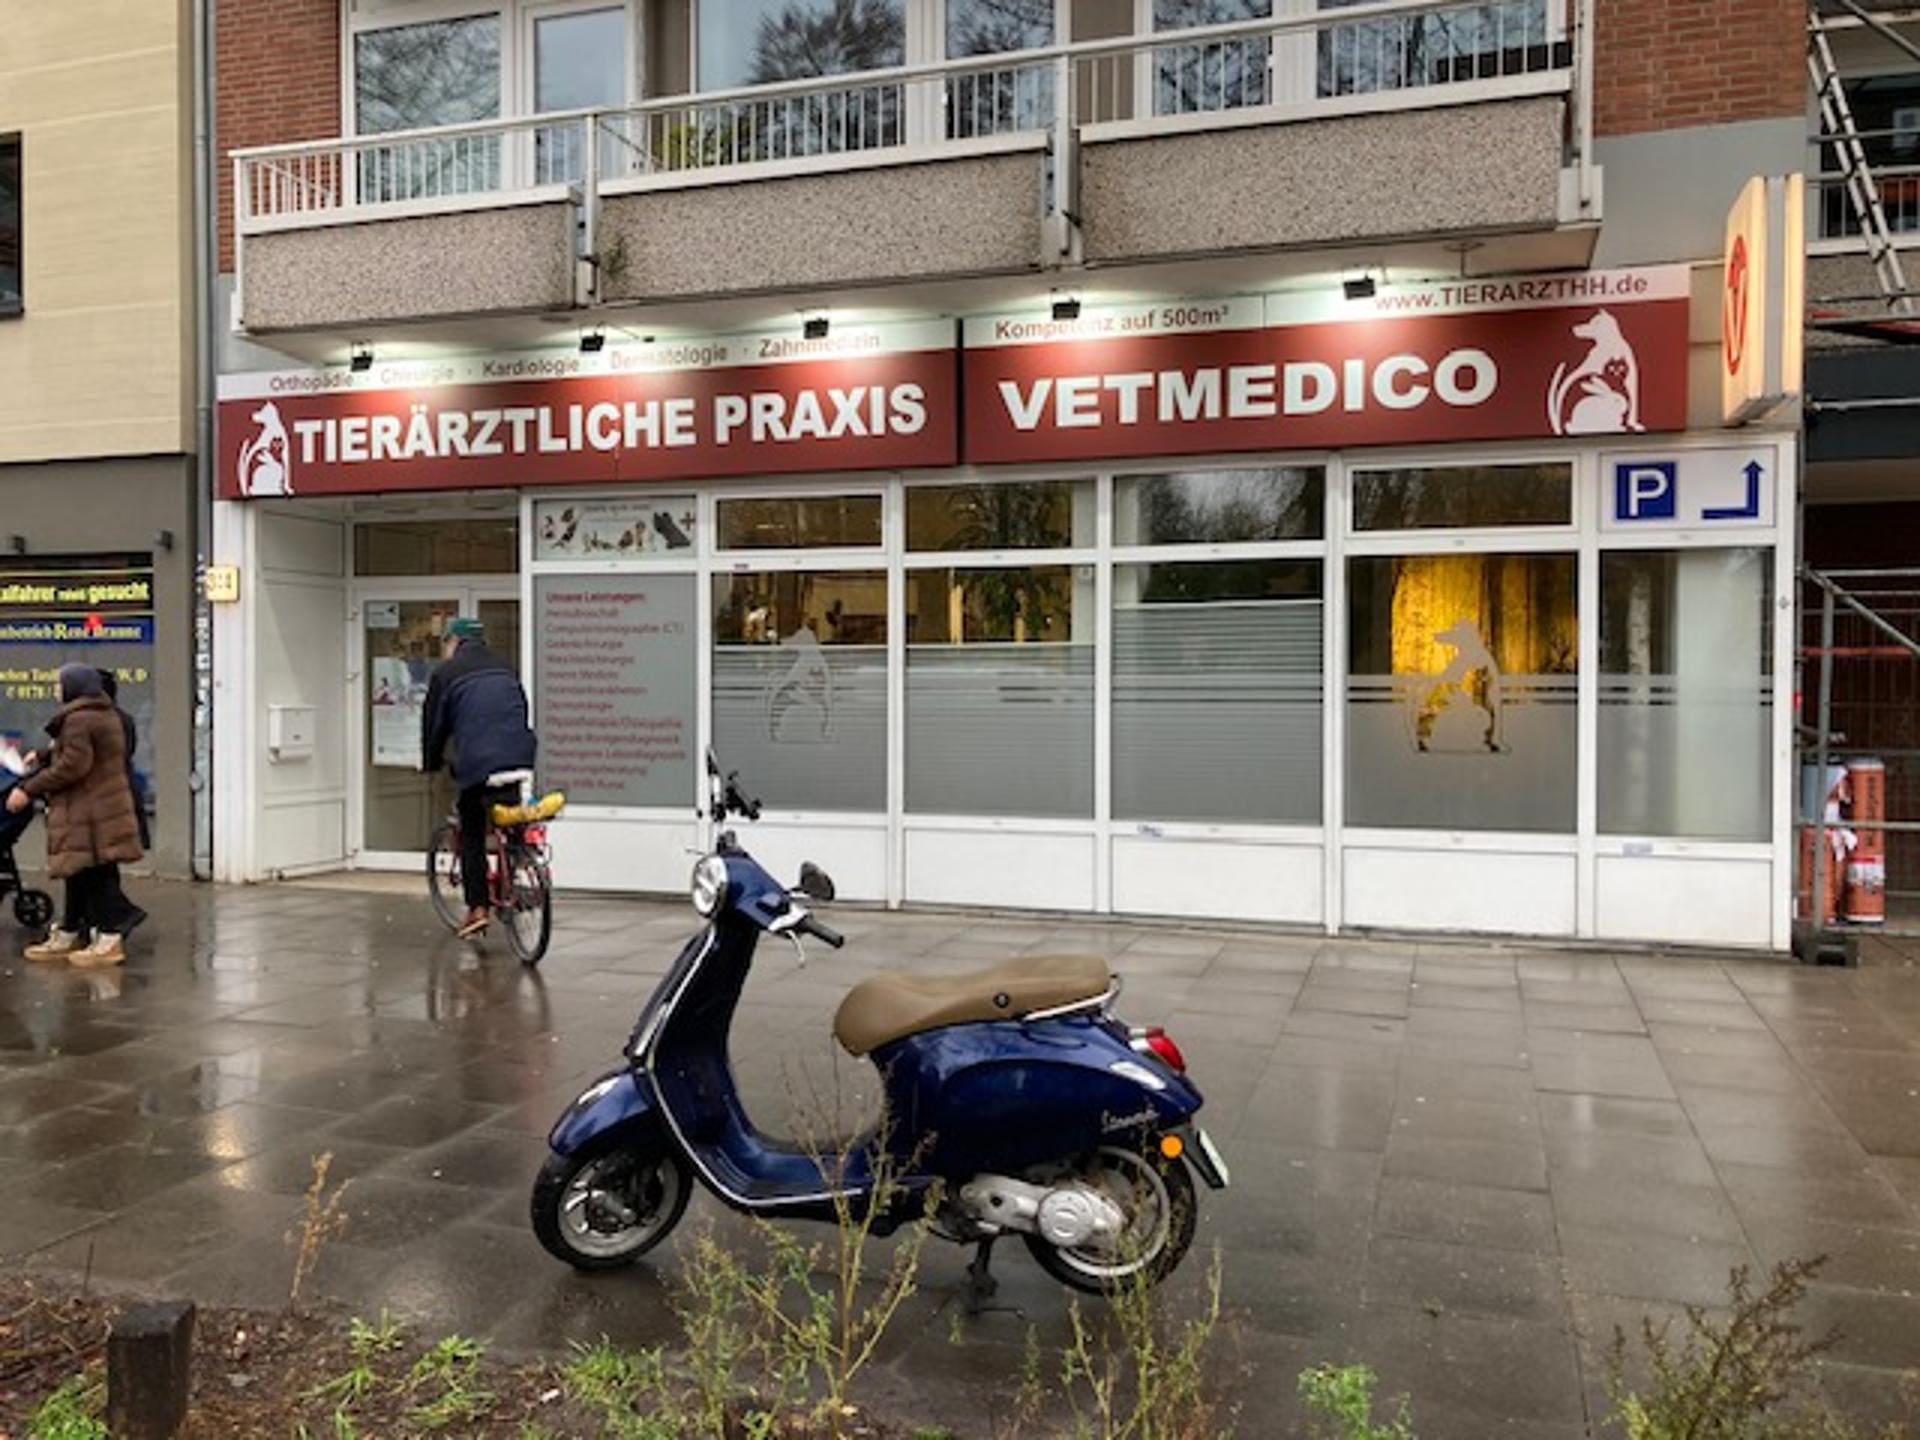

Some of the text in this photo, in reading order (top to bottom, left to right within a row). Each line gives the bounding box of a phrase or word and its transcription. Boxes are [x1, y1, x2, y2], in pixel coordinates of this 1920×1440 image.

[1375, 273, 1648, 309] www.TIERARZTHH.de
[995, 319, 1114, 339] Kompetenz
[1120, 314, 1155, 331] auf
[269, 332, 881, 392] Orthopädie Chirurgie Kardiologie Dermatologie Zahnmedizin
[999, 347, 1499, 431] VETMEDICO
[293, 382, 927, 464] TIERÄRZTLICHE PRAXIS
[1628, 468, 1669, 517] P
[88, 581, 149, 604] gesucht
